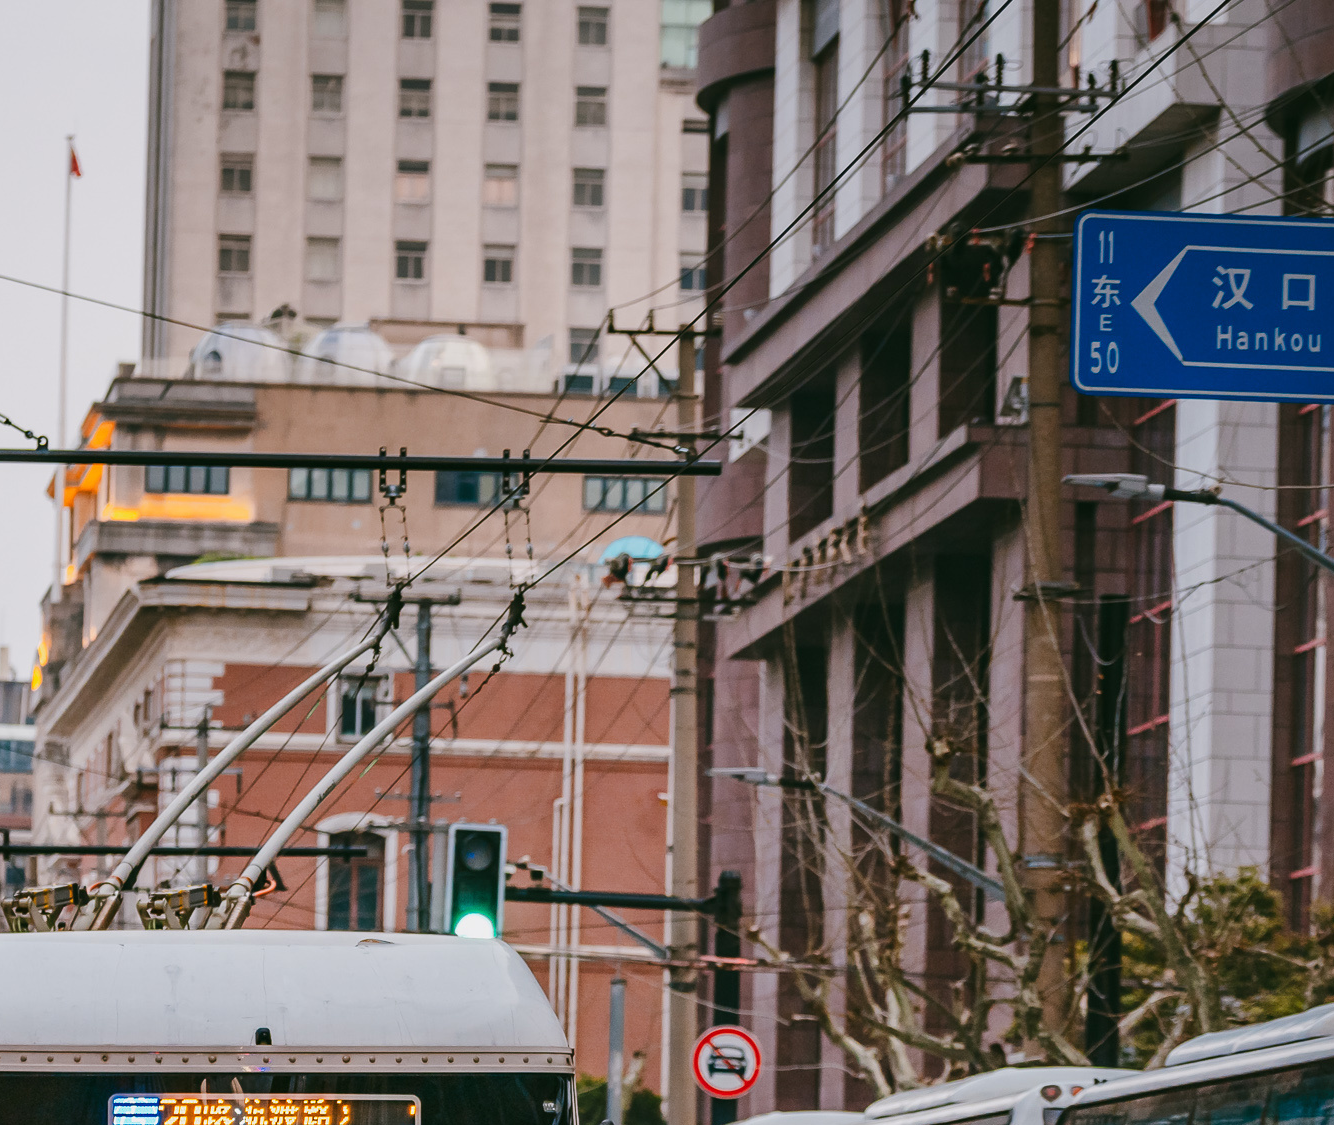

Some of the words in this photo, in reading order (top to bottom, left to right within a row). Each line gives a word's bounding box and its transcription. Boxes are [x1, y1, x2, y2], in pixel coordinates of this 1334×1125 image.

[1098, 230, 1115, 264] 11
[1090, 274, 1122, 309] 东
[1099, 313, 1113, 332] E
[1216, 324, 1322, 354] Hankou
[1089, 341, 1120, 374] 50
